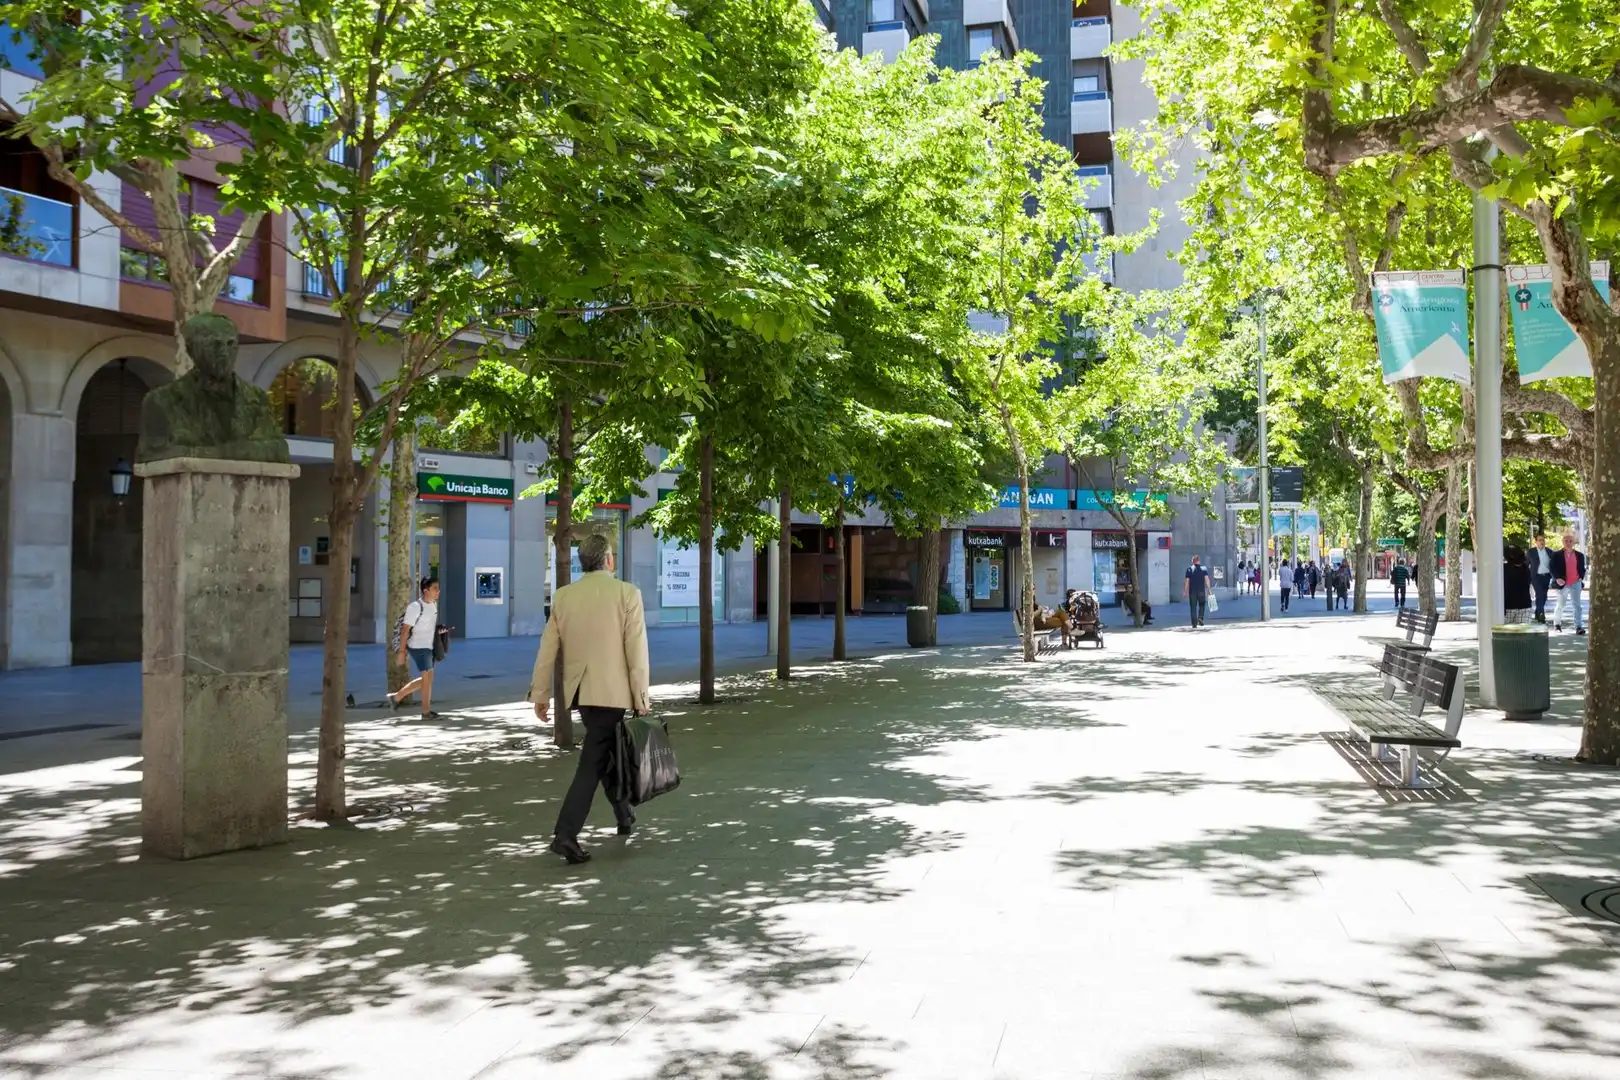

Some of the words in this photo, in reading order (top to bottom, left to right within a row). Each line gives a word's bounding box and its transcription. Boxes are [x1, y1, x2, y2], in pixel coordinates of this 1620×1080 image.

[1400, 304, 1455, 312] Americana
[446, 481, 481, 495] Unicaja
[482, 484, 508, 495] Banco
[968, 536, 1003, 546] kutxabank
[1094, 539, 1128, 548] kutxabank
